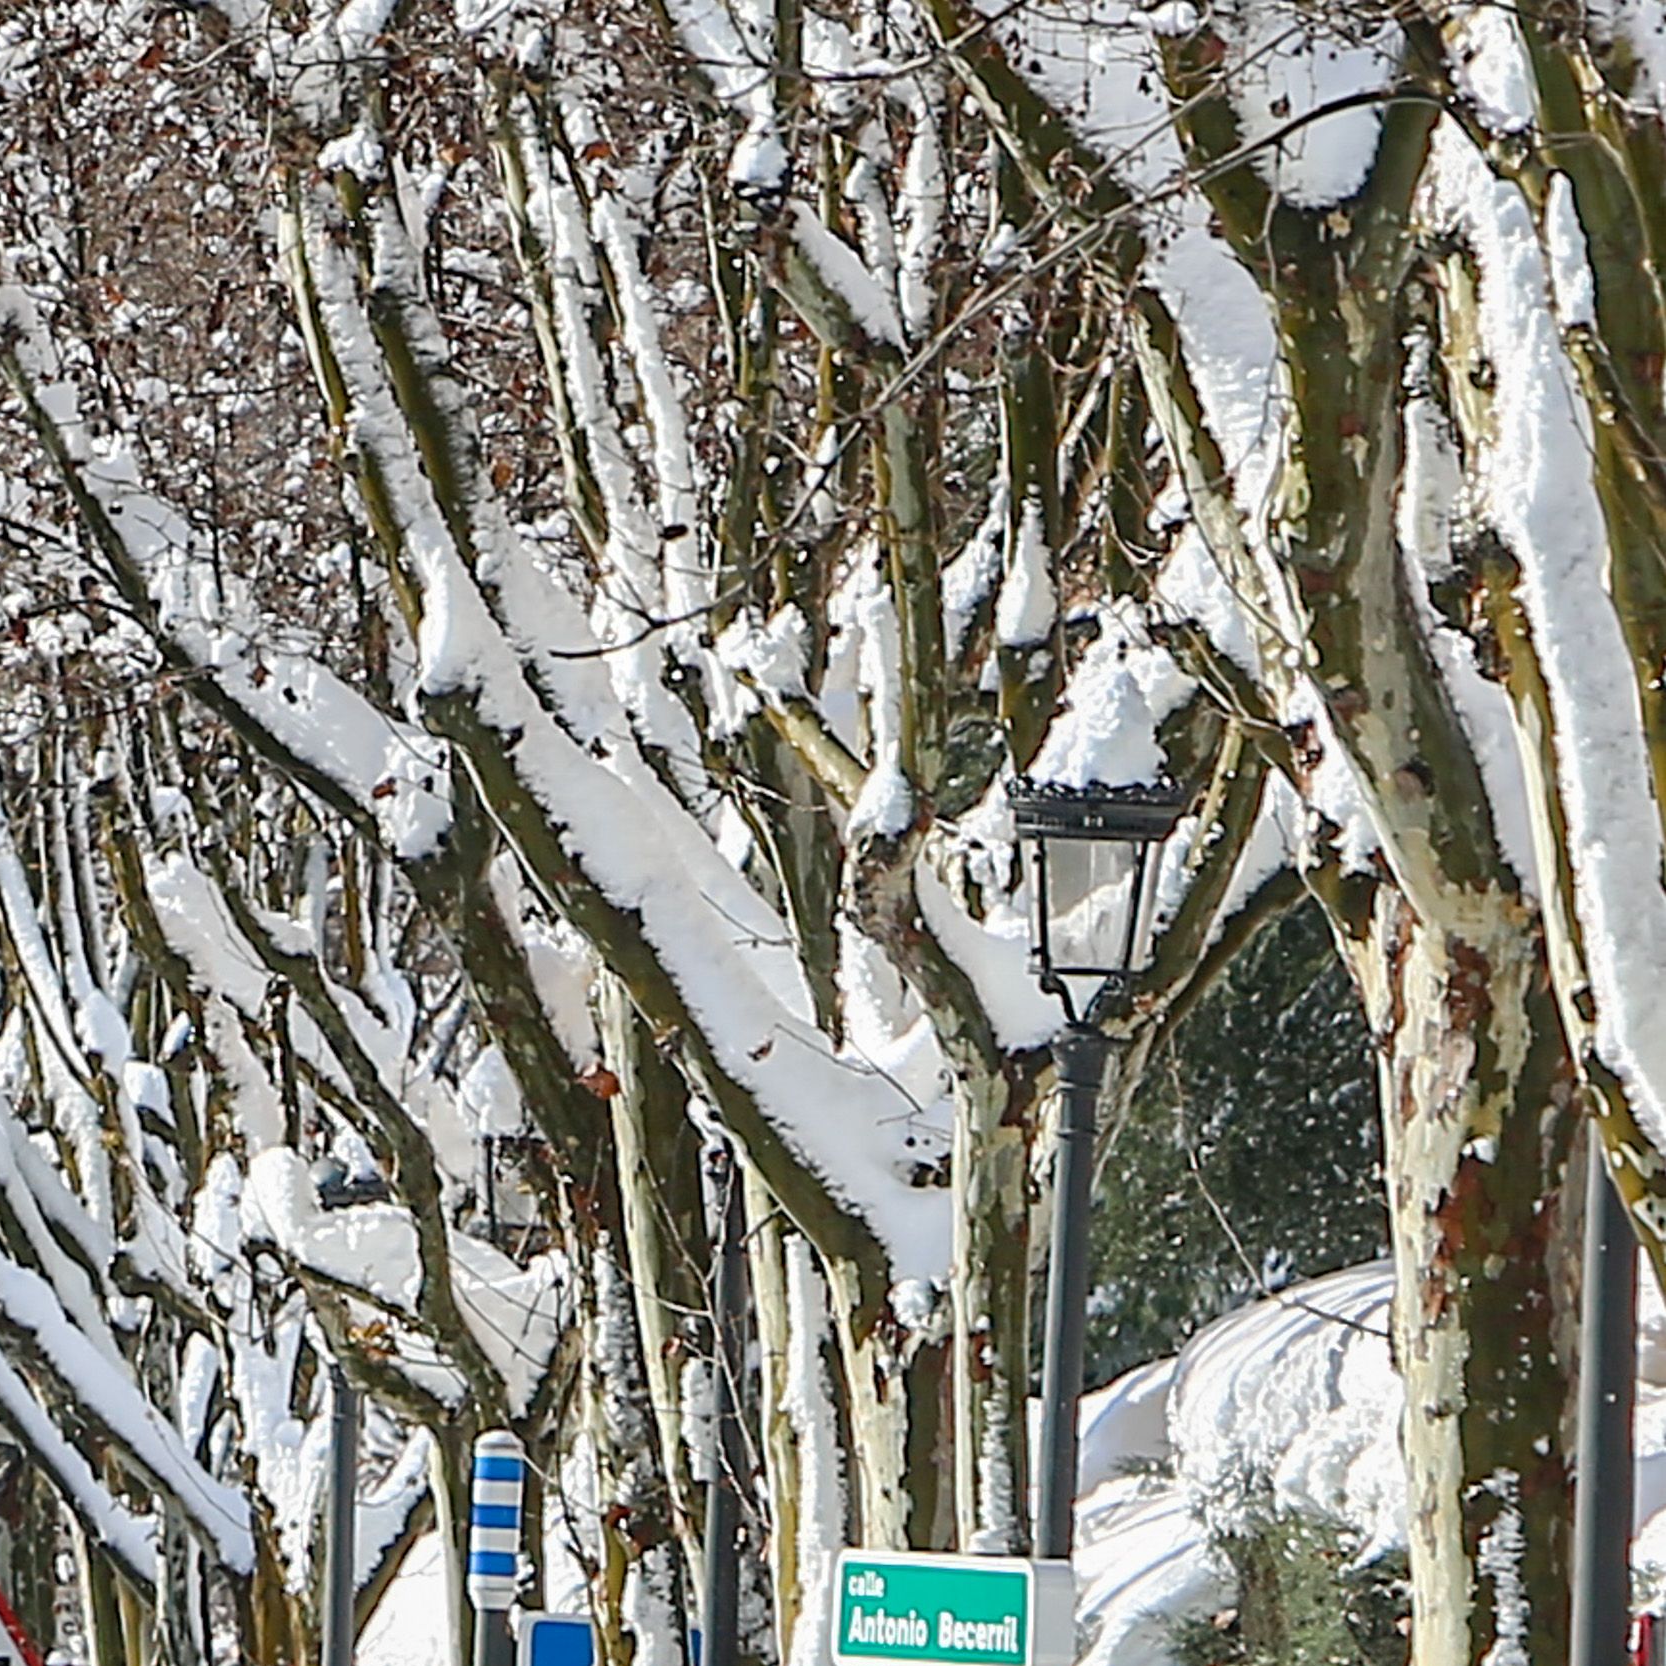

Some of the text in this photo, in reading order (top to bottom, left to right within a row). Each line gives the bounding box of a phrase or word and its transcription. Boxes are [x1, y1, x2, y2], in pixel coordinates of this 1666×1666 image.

[848, 1570, 885, 1598] calle
[848, 1606, 1020, 1654] Antonio Becerril
